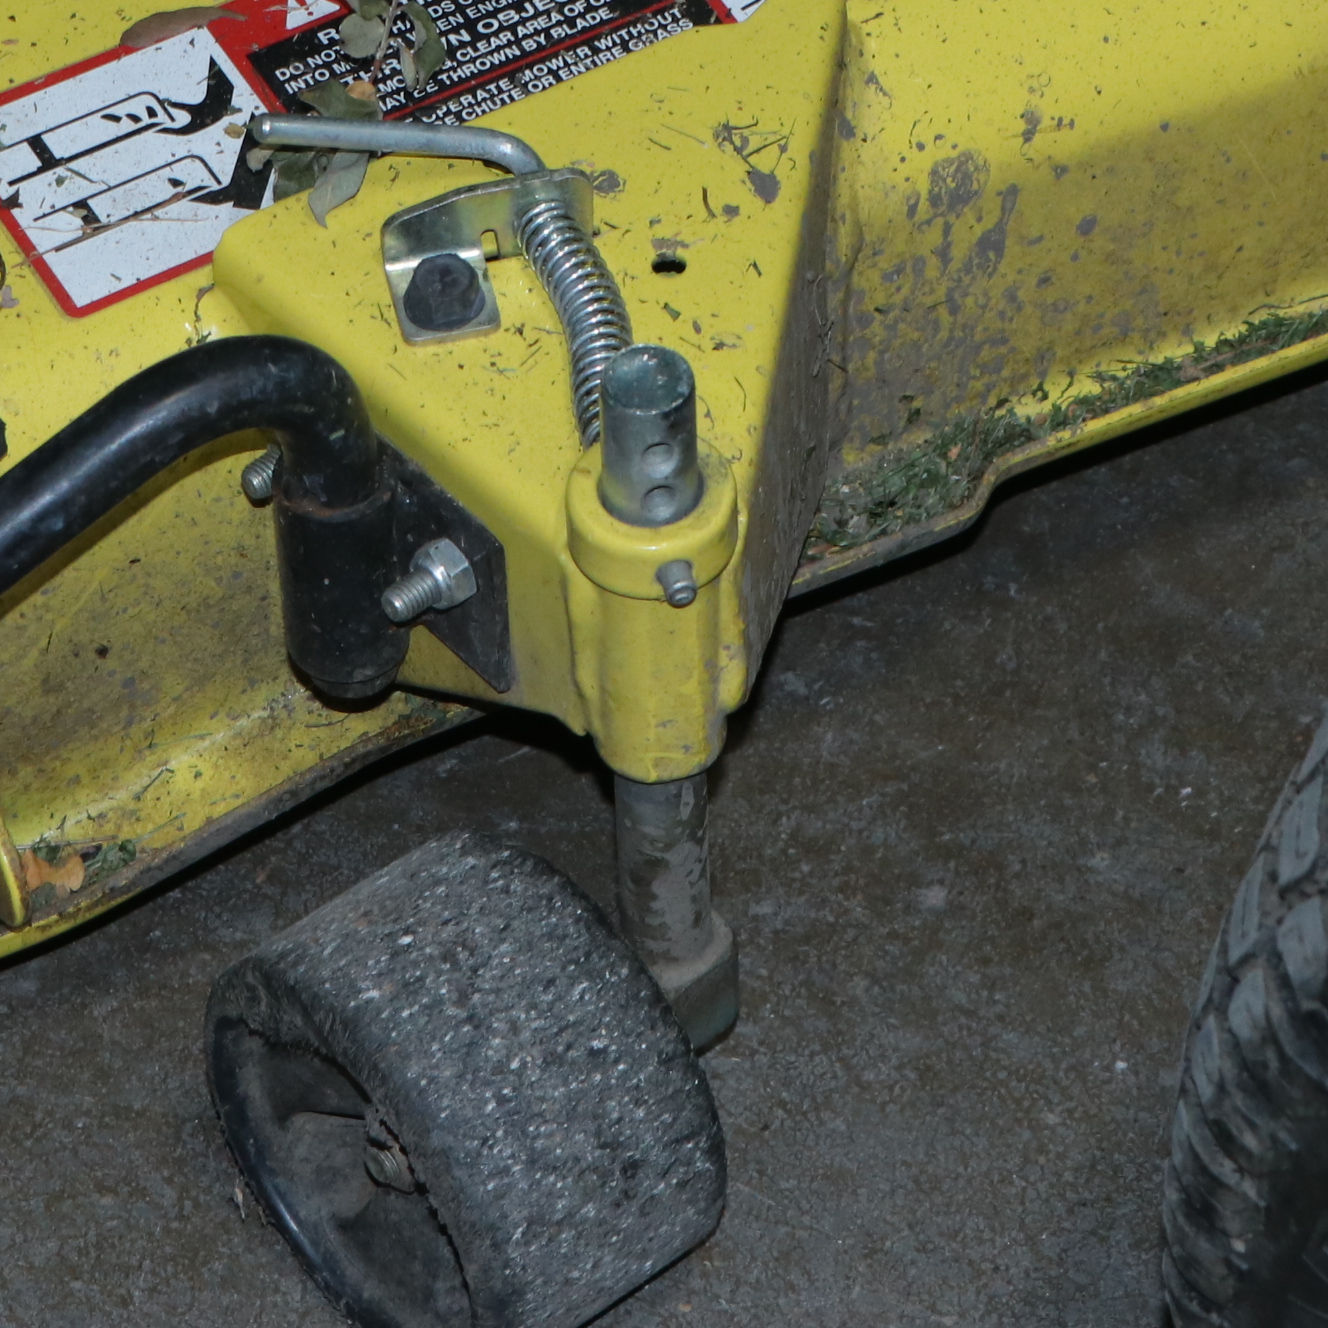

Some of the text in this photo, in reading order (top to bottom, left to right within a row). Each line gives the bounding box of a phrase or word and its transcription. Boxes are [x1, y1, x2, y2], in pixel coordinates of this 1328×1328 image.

[437, 43, 522, 86] THROWN
[521, 32, 548, 53] BY
[550, 7, 615, 40] BLADE
[456, 31, 515, 63] CLEAR
[516, 12, 565, 39] AREA
[563, 0, 588, 18] OF
[520, 45, 592, 84] MOWER
[594, 7, 684, 51] WITHOUT
[275, 62, 305, 82] DO
[284, 68, 330, 95] INTO
[461, 87, 525, 121] CHUTE
[527, 75, 557, 94] OR
[558, 48, 627, 81] ENTIRE
[628, 18, 694, 52] GRASS
